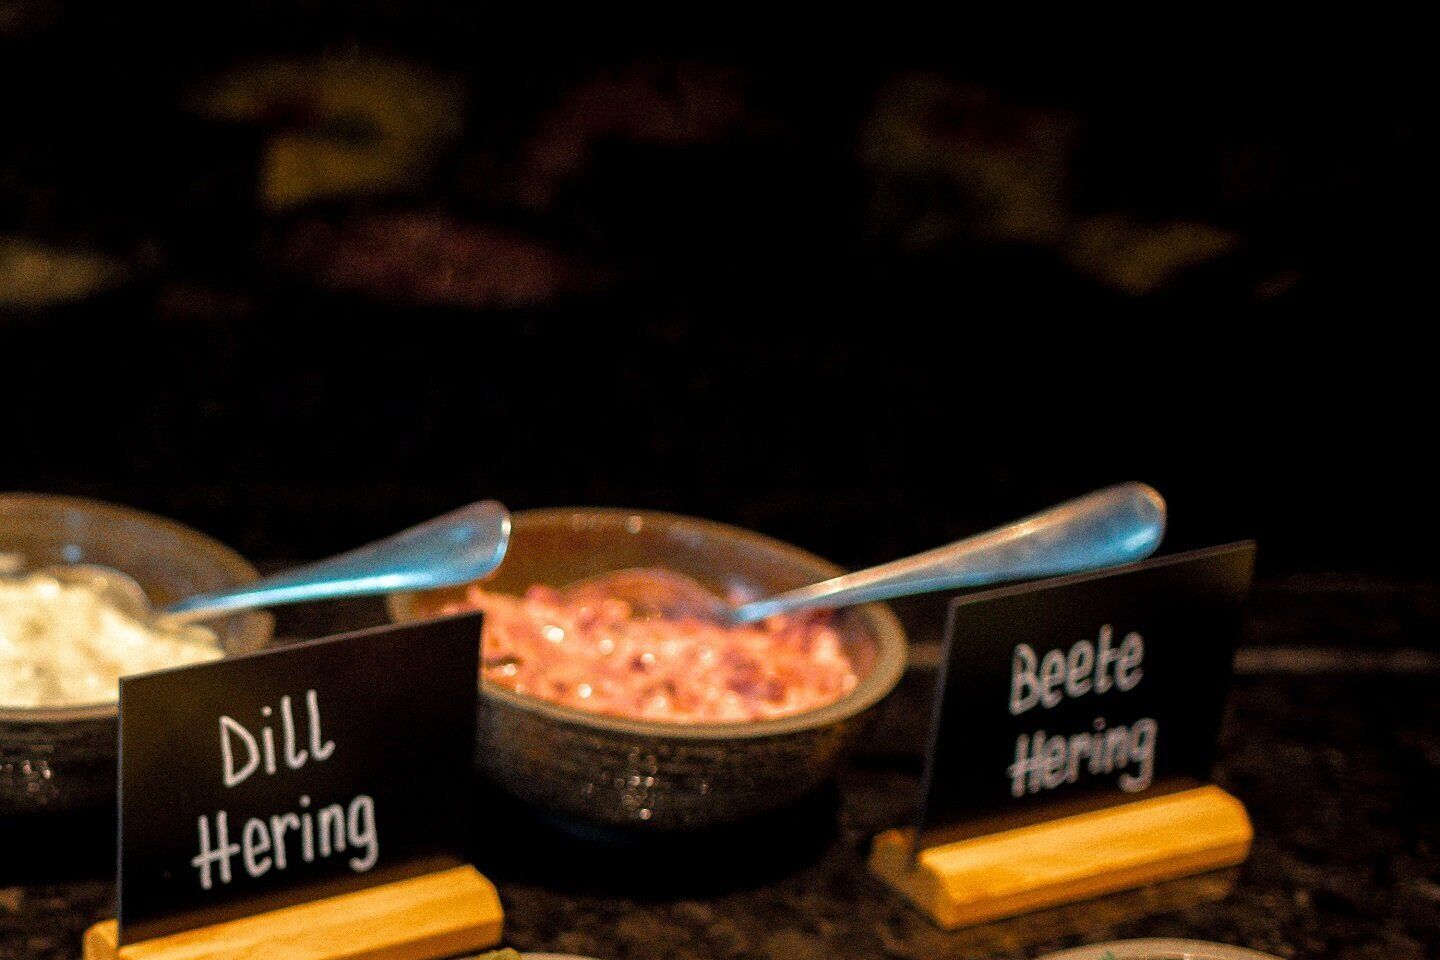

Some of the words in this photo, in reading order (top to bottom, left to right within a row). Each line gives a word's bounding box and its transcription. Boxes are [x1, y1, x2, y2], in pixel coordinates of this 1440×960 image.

[1008, 624, 1144, 715] Beete
[219, 690, 335, 787] Dill
[1007, 717, 1157, 798] Hering
[191, 795, 379, 890] Hering
